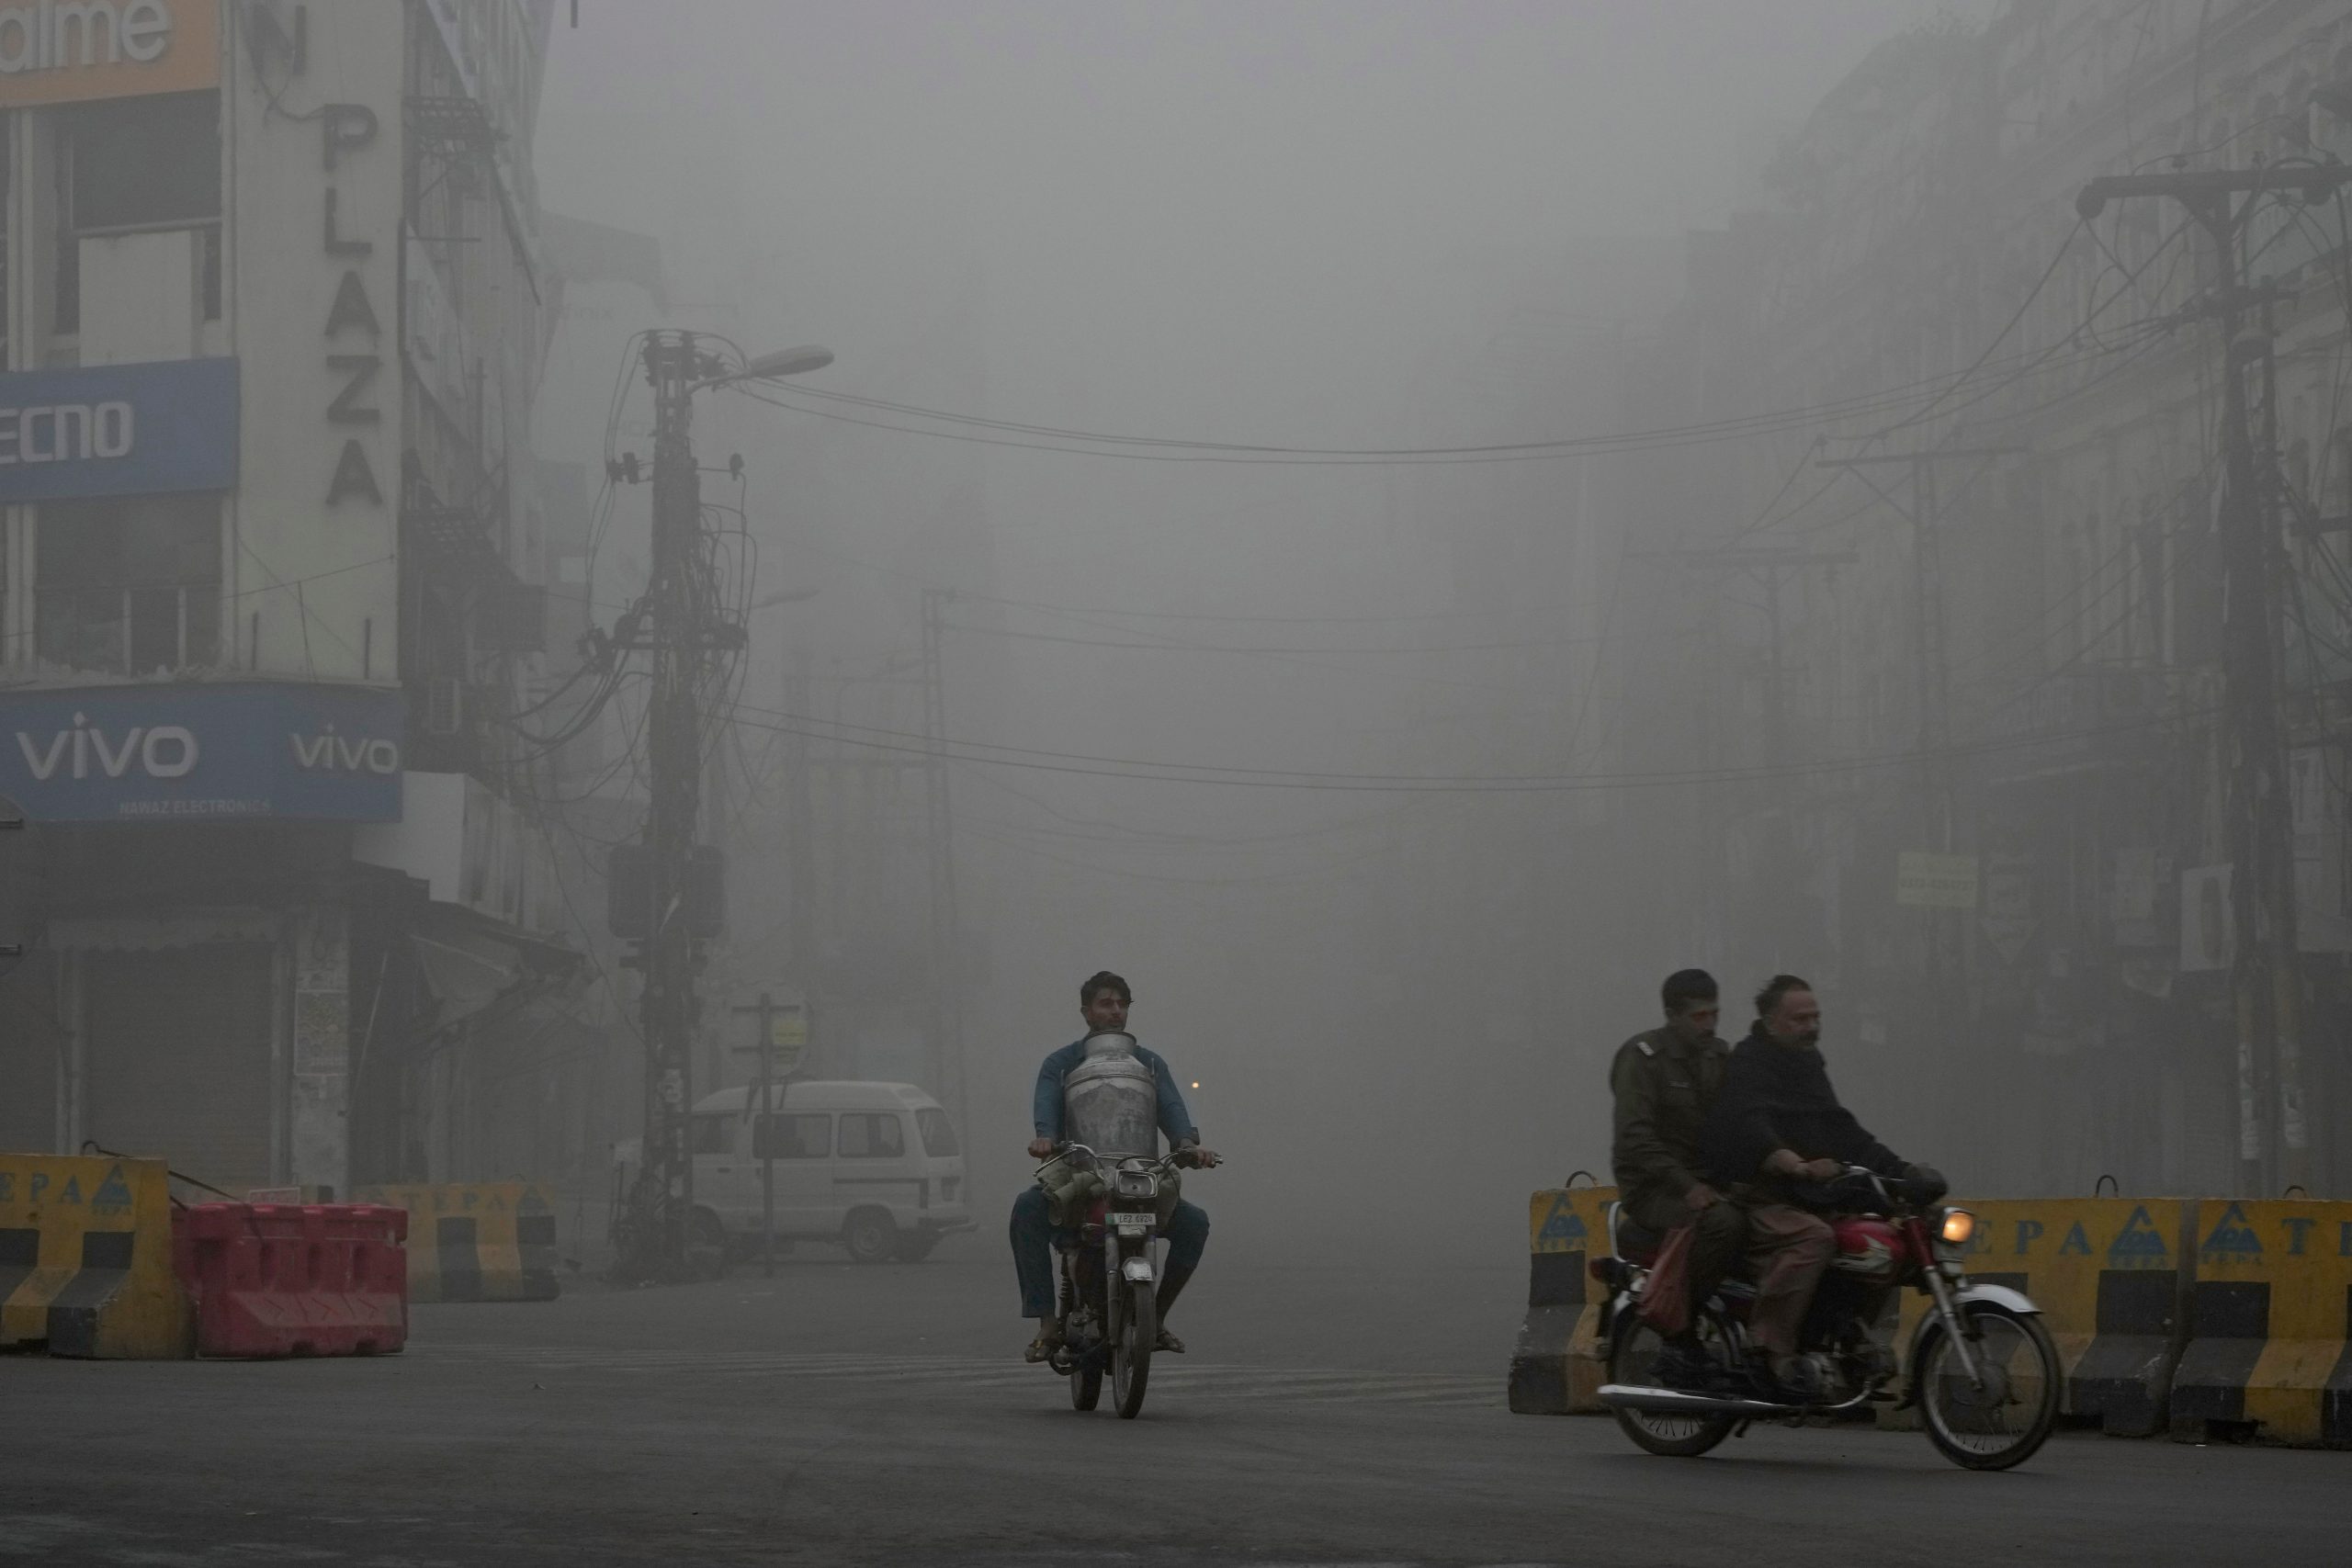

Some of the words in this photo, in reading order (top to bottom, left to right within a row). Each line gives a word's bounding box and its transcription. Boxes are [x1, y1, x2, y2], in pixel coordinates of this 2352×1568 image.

[322, 103, 382, 505] PLAZA
[16, 711, 198, 780] vivo
[292, 722, 399, 774] vivo
